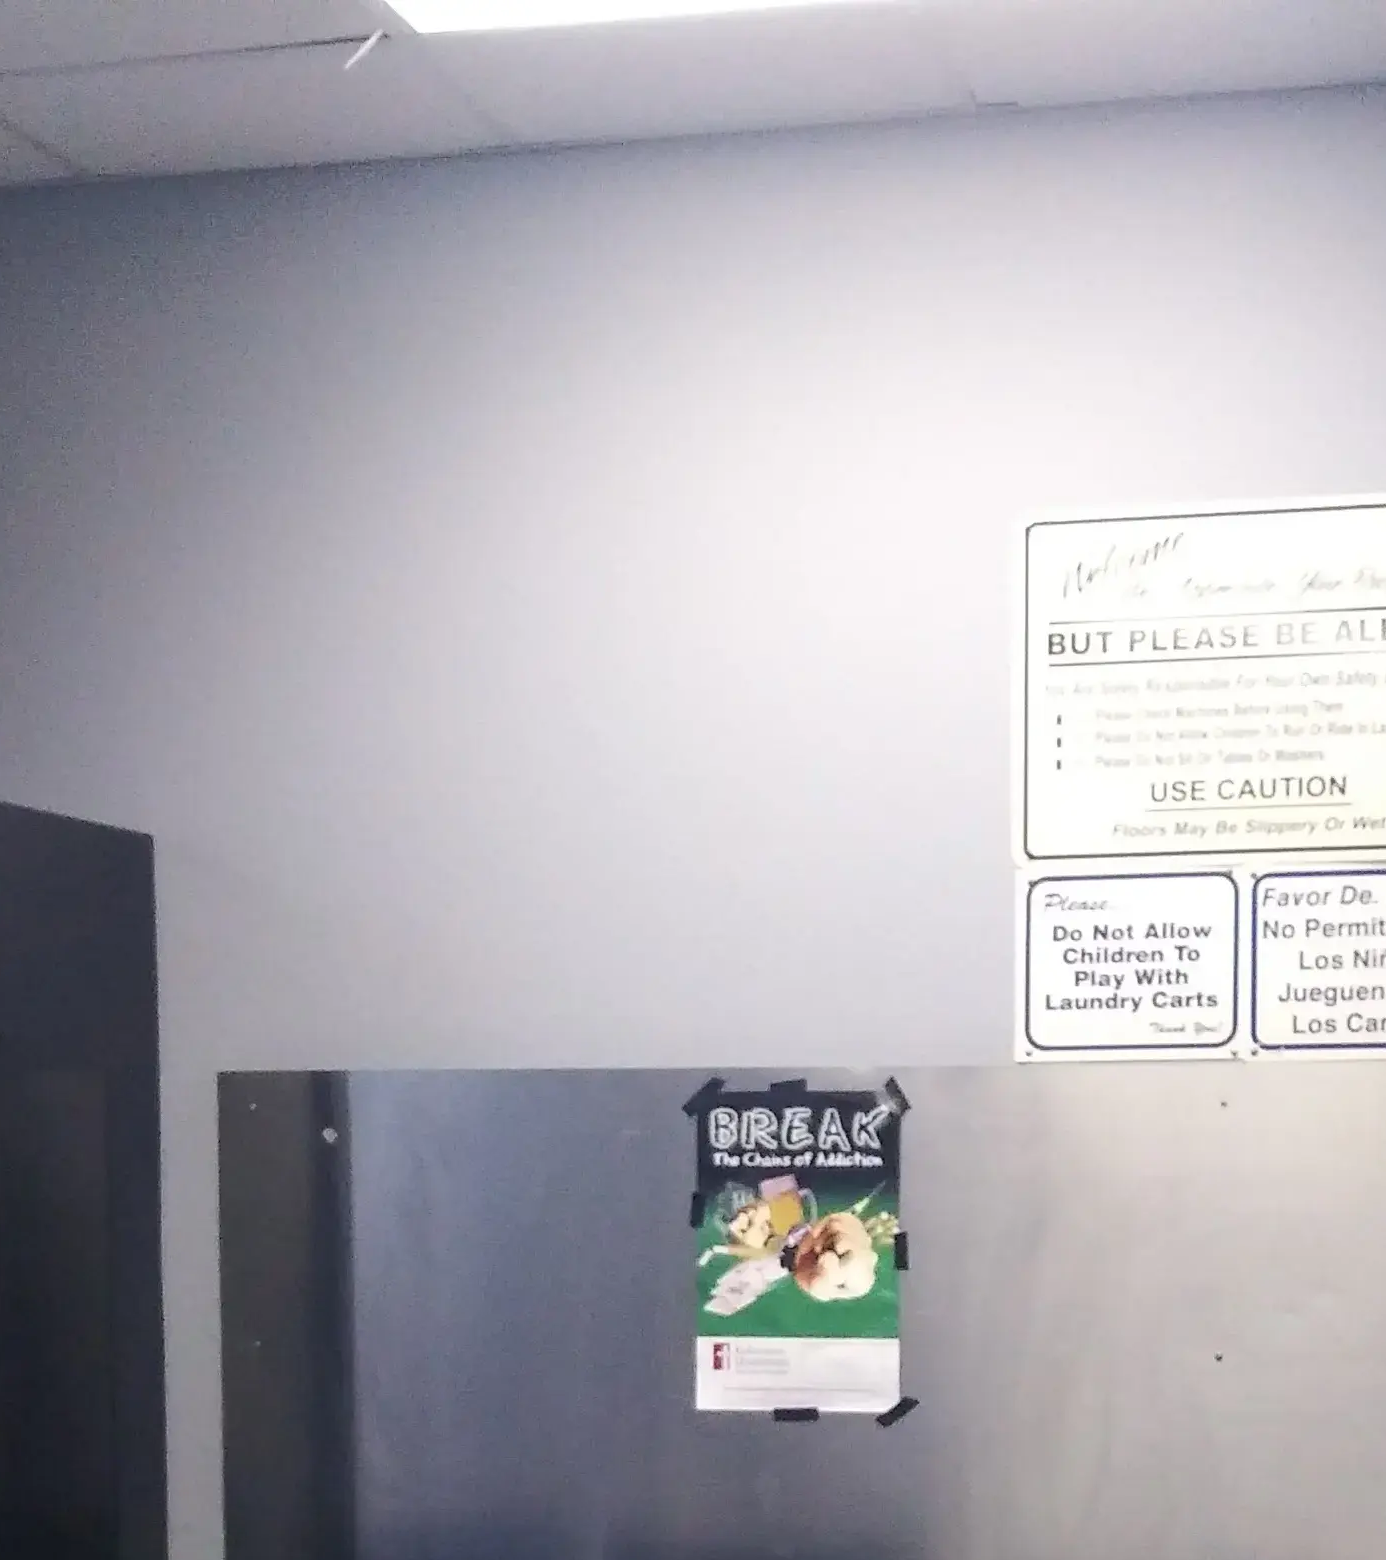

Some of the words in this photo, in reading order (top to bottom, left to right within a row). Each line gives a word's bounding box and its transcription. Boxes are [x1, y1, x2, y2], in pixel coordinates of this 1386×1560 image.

[1048, 632, 1113, 656] BUT
[1129, 625, 1259, 653] PLEASE
[1276, 622, 1319, 646] BE
[1150, 780, 1206, 802] USE
[1217, 775, 1348, 800] CAUTION
[1112, 823, 1167, 838] Floors
[1174, 822, 1208, 838] May
[1215, 820, 1237, 834] Be
[1246, 818, 1316, 836] Slippery
[1324, 816, 1345, 831] Or
[1352, 816, 1386, 829] Wet
[1262, 887, 1332, 907] Favor
[1052, 925, 1083, 942] Do
[1093, 924, 1134, 941] Not
[1145, 922, 1212, 939] Allow
[1262, 920, 1295, 939] No
[1063, 946, 1164, 965] Children
[1175, 945, 1200, 962] To
[1299, 951, 1343, 970] Los
[1074, 970, 1124, 990] Play
[1135, 968, 1189, 986] With
[1045, 992, 1142, 1013] Laundry
[1152, 991, 1218, 1008] Carts
[1278, 982, 1385, 1007] Jueguen
[1292, 1014, 1337, 1034] Los
[709, 1104, 891, 1151] BREAK
[713, 1152, 740, 1167] The
[743, 1152, 792, 1167] Chains
[794, 1152, 813, 1167] of
[815, 1152, 883, 1167] Addiction
